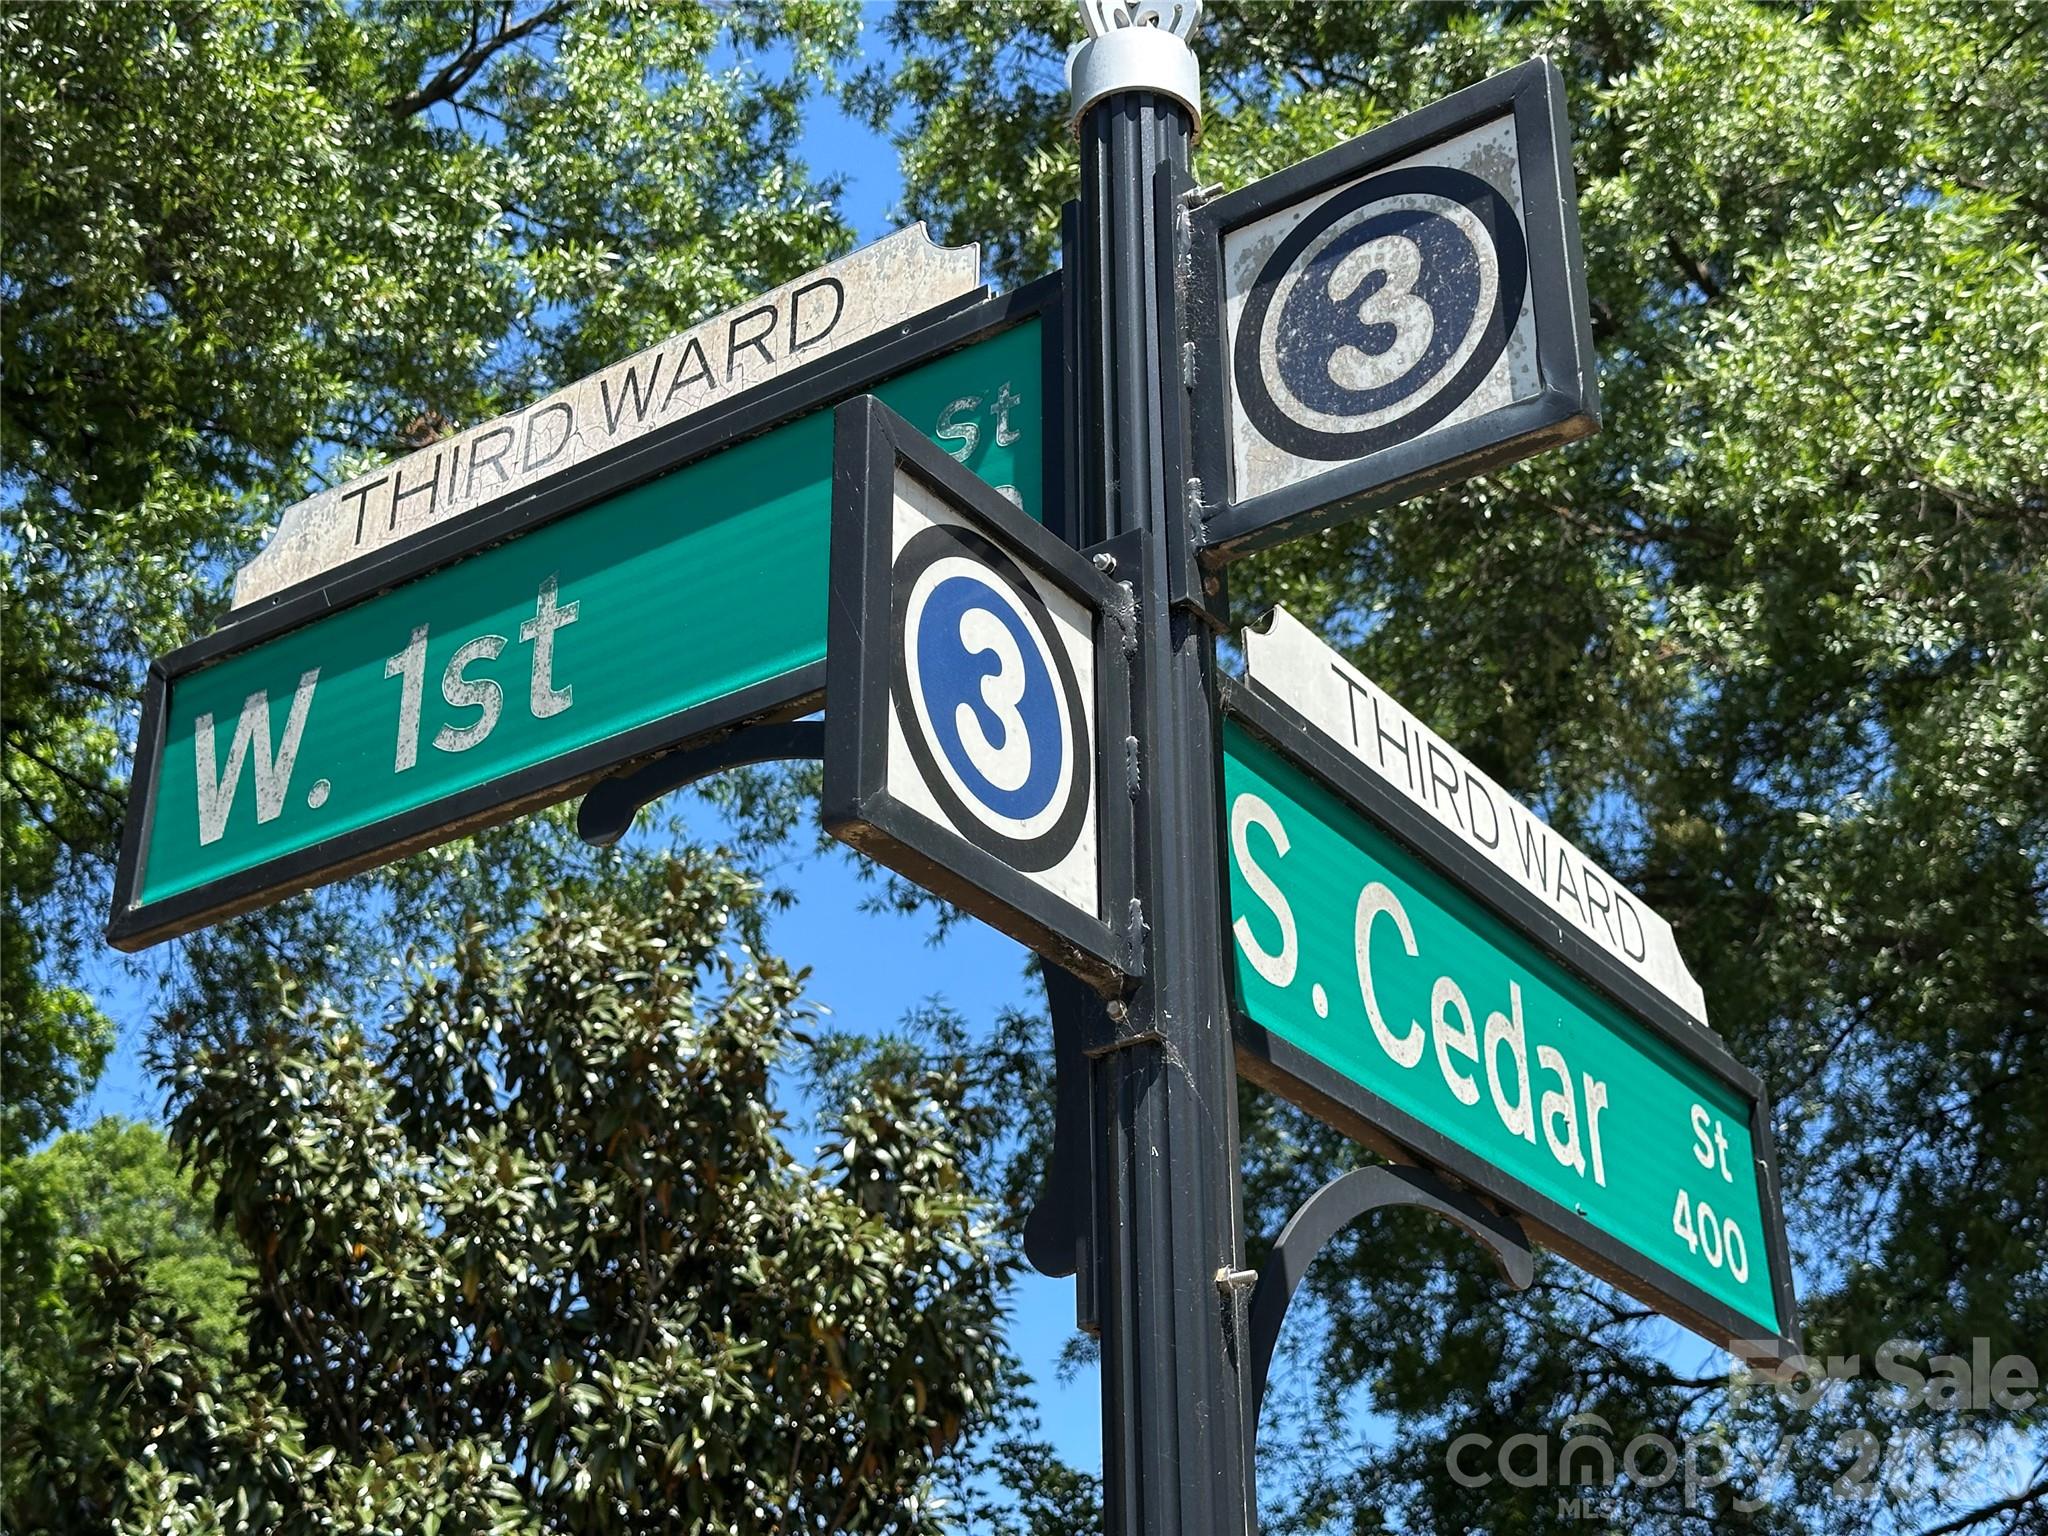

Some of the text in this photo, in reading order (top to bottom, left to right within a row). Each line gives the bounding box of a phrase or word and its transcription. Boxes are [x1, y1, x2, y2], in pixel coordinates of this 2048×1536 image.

[341, 276, 844, 549] THIRD WARD
[1327, 235, 1434, 391] 3
[194, 573, 579, 847] W. 1st
[954, 607, 1032, 793] 3
[1330, 662, 1646, 965] THIRD WARD
[1230, 792, 1608, 1188] S. Cedar
[1672, 1188, 1749, 1284] 400
[1690, 1103, 1734, 1184] St
